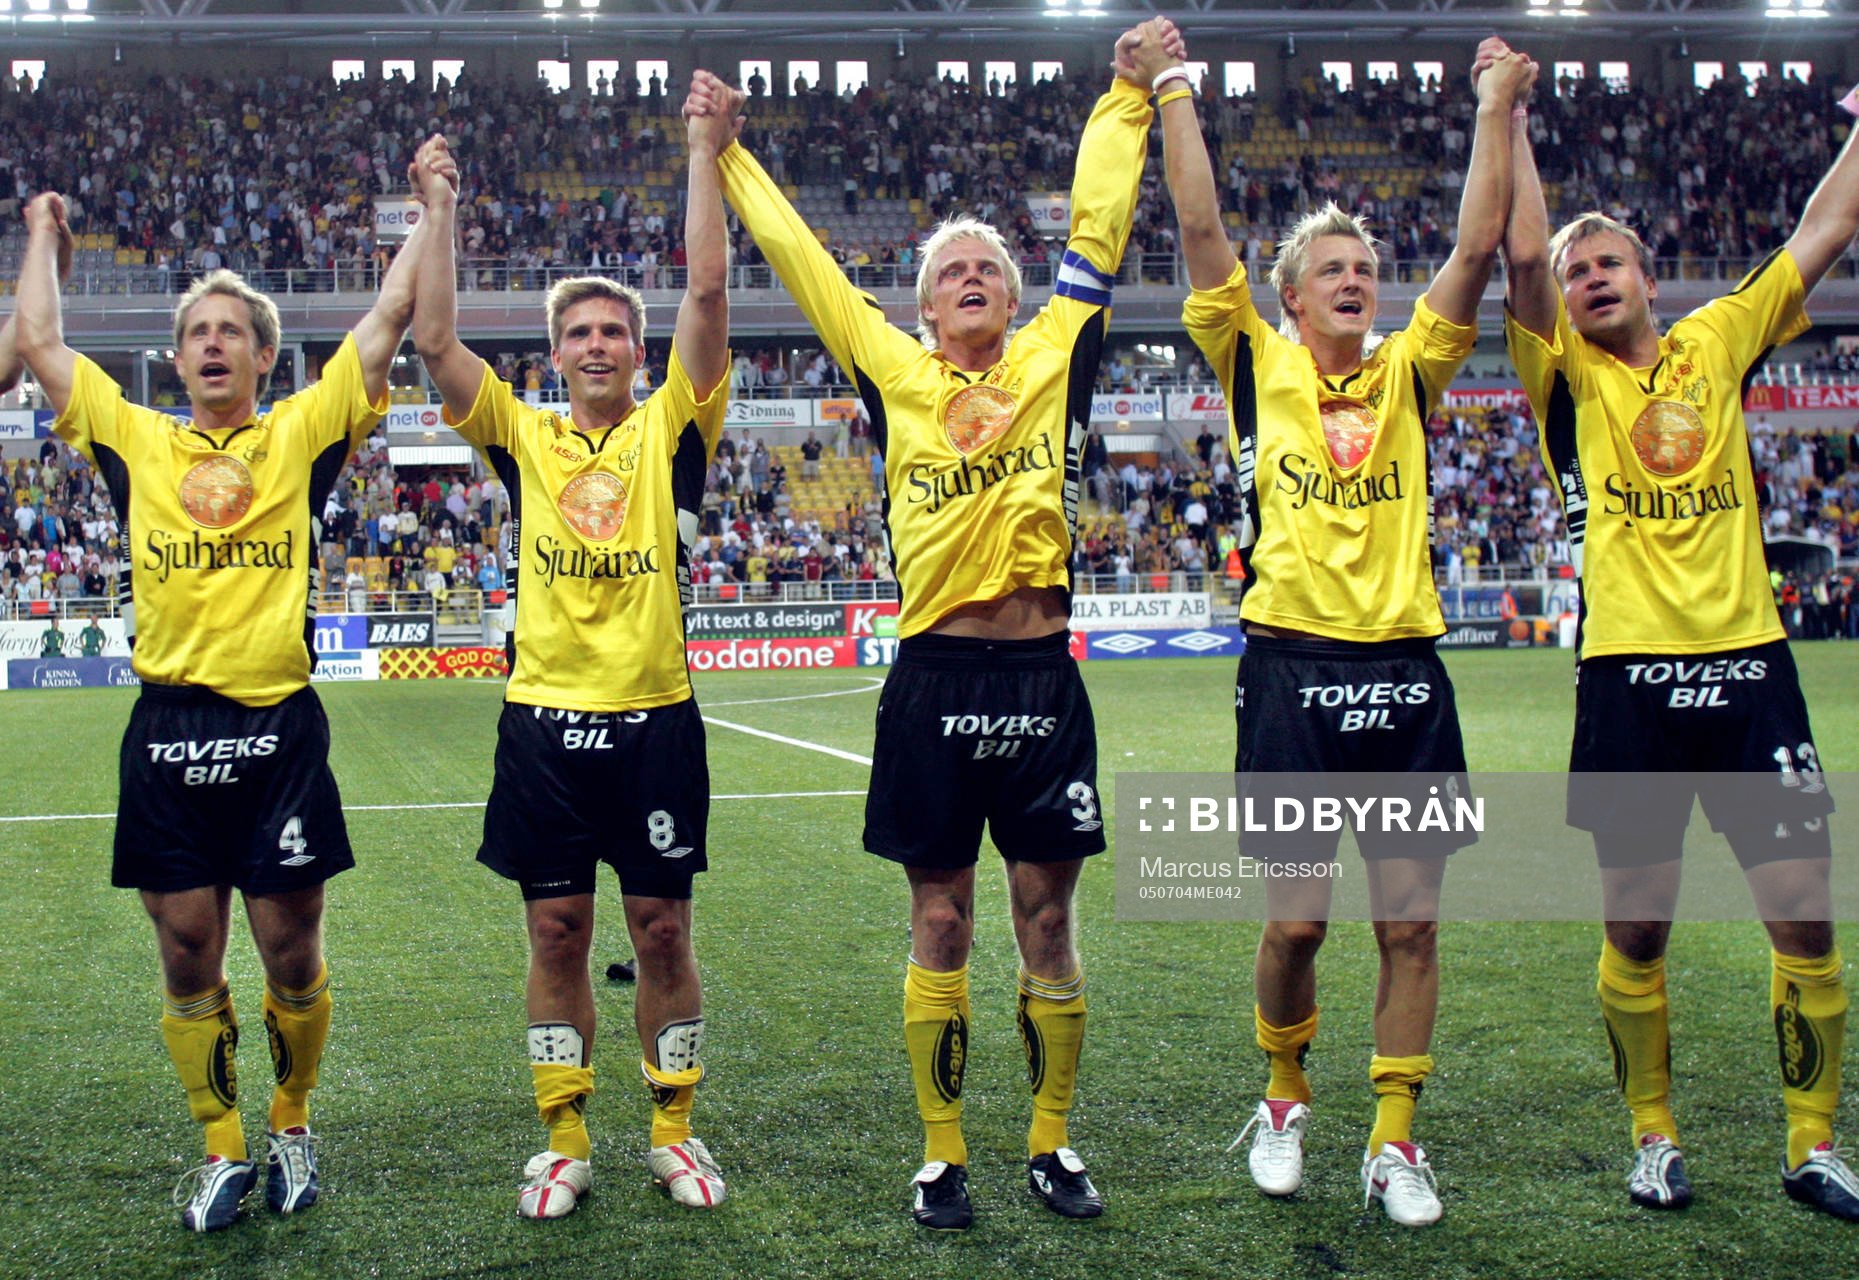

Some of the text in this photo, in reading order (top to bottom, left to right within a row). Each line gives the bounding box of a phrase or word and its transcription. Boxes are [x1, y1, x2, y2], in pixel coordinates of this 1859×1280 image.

[376, 210, 403, 224] net
[1031, 208, 1048, 220] et
[389, 409, 420, 425] net
[1132, 400, 1161, 414] net
[144, 529, 295, 583] Sjuhärad
[1109, 601, 1172, 616] PLAST
[1179, 600, 1206, 615] AB
[714, 611, 750, 629] text
[754, 611, 769, 628] &
[369, 623, 430, 644] BAES
[445, 652, 479, 669] GOD
[863, 637, 900, 665] ST
[45, 669, 77, 679] KINNA
[1625, 659, 1768, 685] TOVEKS
[1298, 682, 1432, 708] TOVEKS
[1667, 685, 1729, 709] BIL
[941, 714, 1057, 736] TOVEKS
[1339, 709, 1395, 732] BIL
[147, 735, 280, 763] TOVEKS
[563, 728, 614, 750] BIL
[973, 739, 1021, 760] BIL
[183, 764, 239, 786] BIL
[1773, 742, 1822, 788] 13
[1066, 781, 1097, 822] 3
[279, 816, 307, 855] 4
[647, 810, 676, 850] 8
